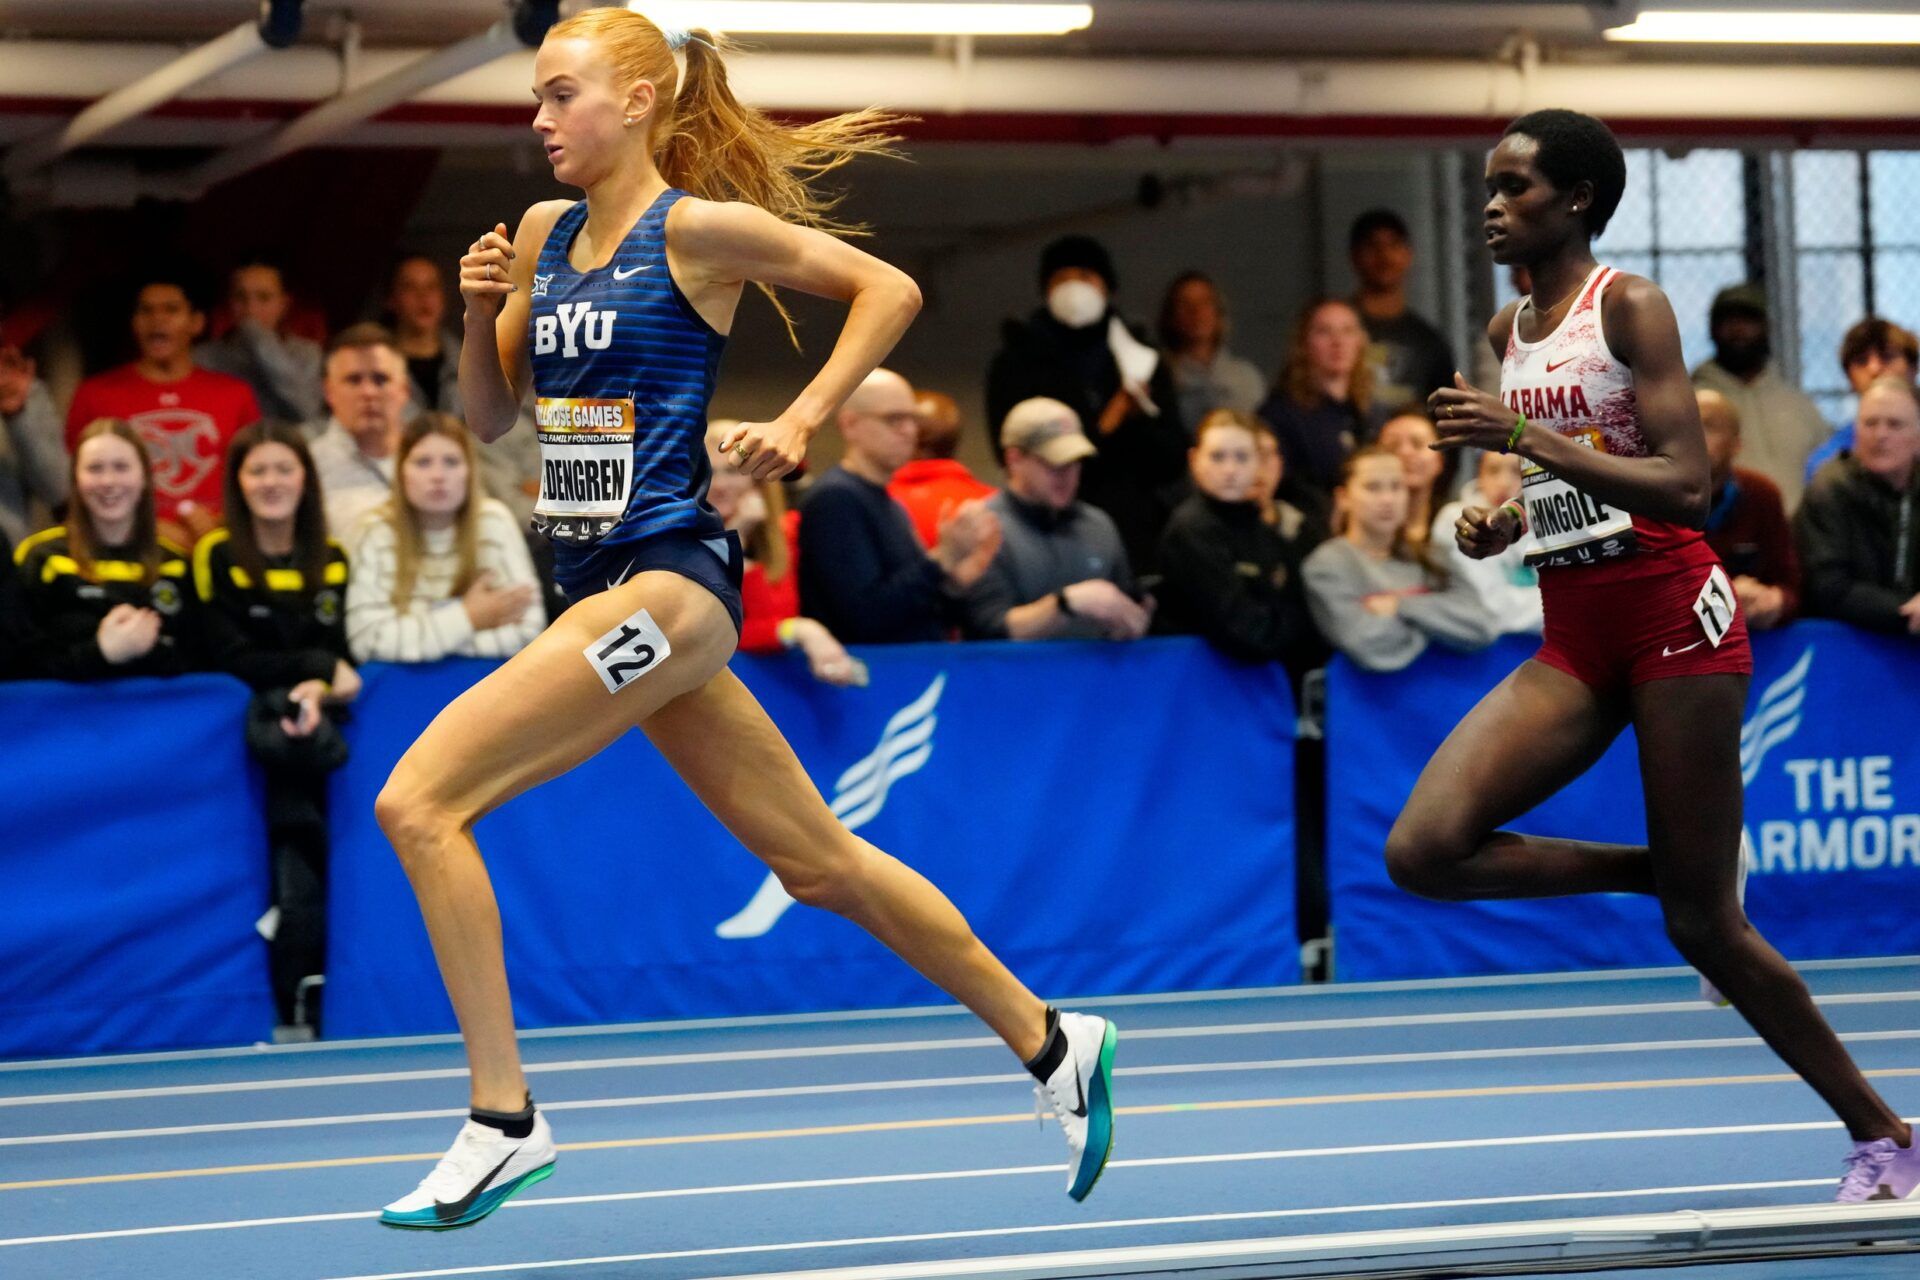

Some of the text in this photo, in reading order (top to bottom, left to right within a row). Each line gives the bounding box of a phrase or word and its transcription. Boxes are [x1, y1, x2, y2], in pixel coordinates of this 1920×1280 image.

[535, 301, 617, 358] BYU
[548, 434, 573, 443] FAMILY
[572, 434, 631, 443] FOUNDATION
[572, 405, 623, 428] GAMES
[543, 459, 625, 502] DENGREN
[1701, 577, 1733, 637] 11
[597, 624, 655, 686] 12
[1784, 755, 1895, 813] THE
